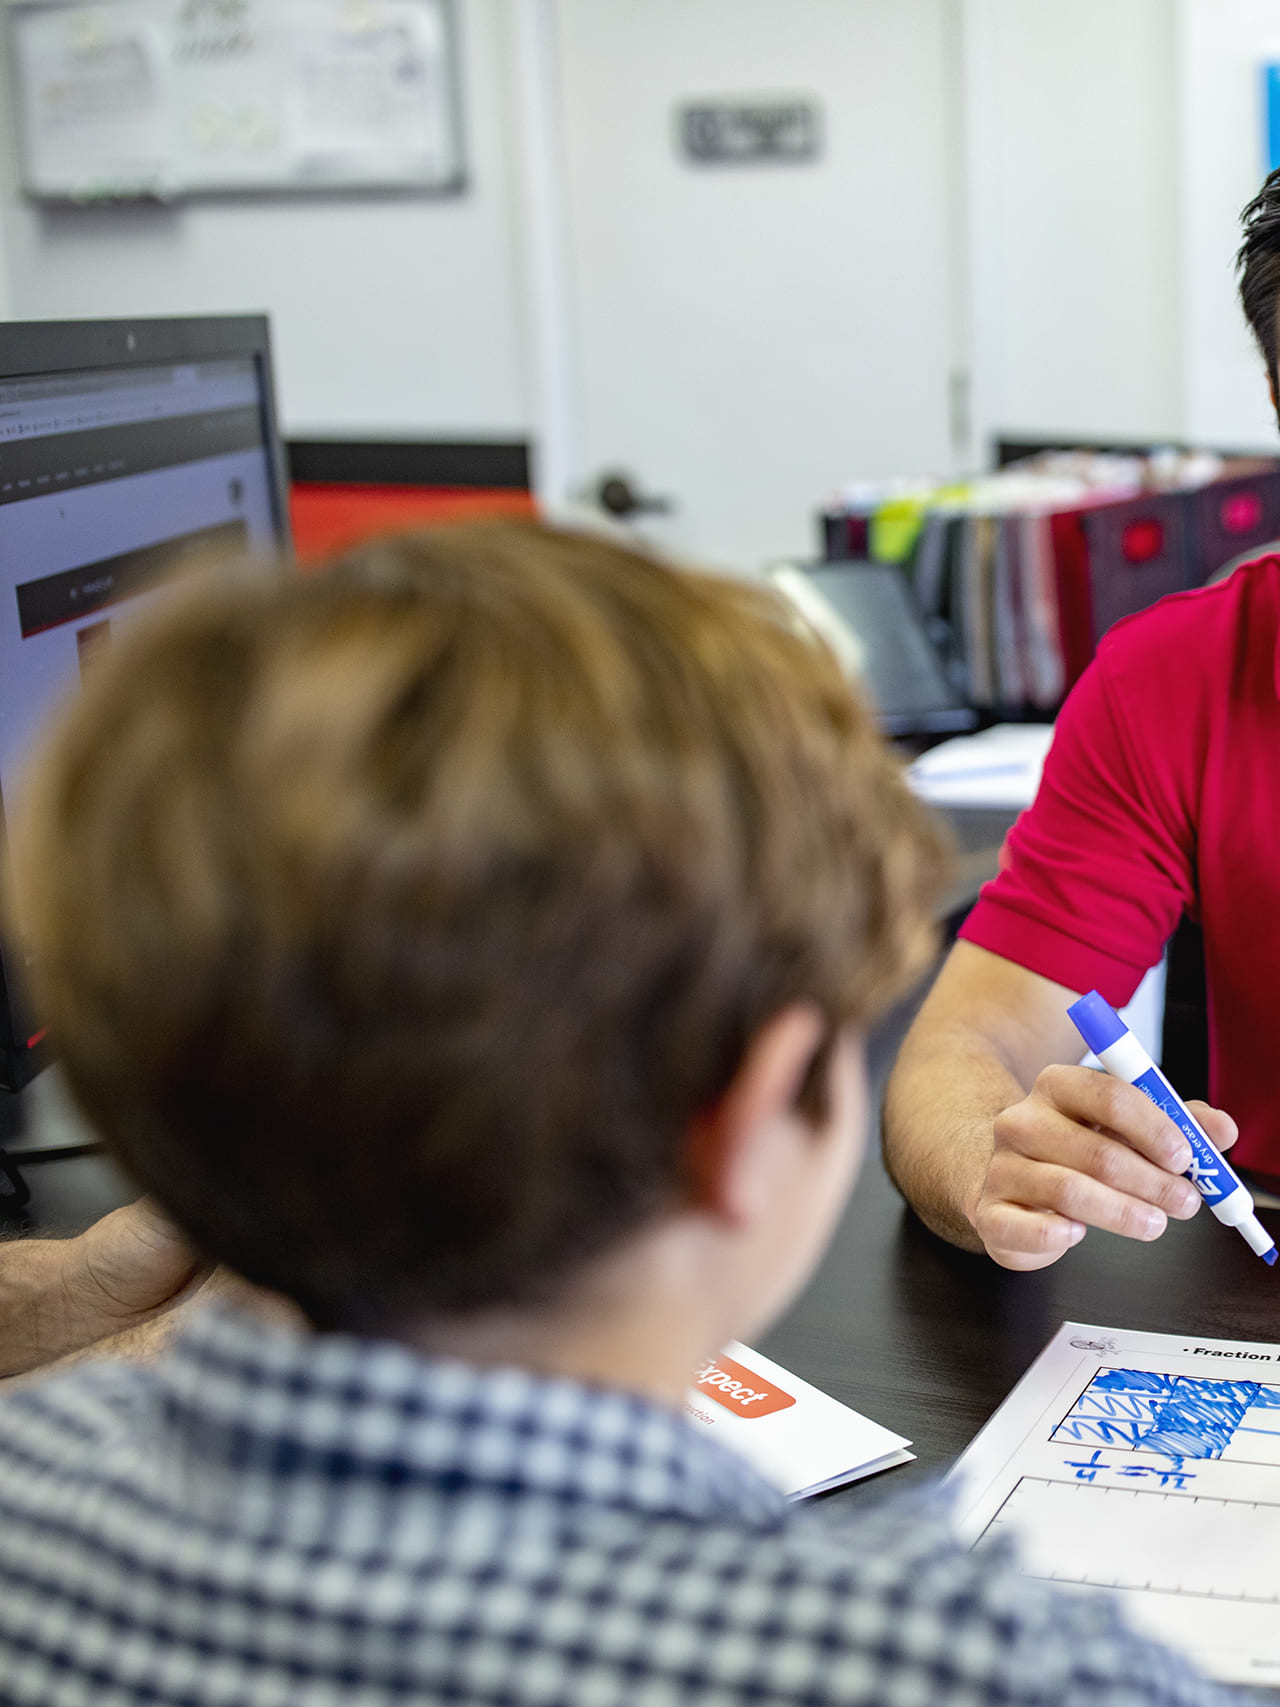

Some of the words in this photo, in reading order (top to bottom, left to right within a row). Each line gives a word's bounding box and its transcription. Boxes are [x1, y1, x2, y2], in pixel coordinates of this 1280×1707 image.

[1182, 1123, 1202, 1149] erase
[1200, 1147, 1214, 1165] dry
[1193, 1347, 1271, 1361] Fraction
